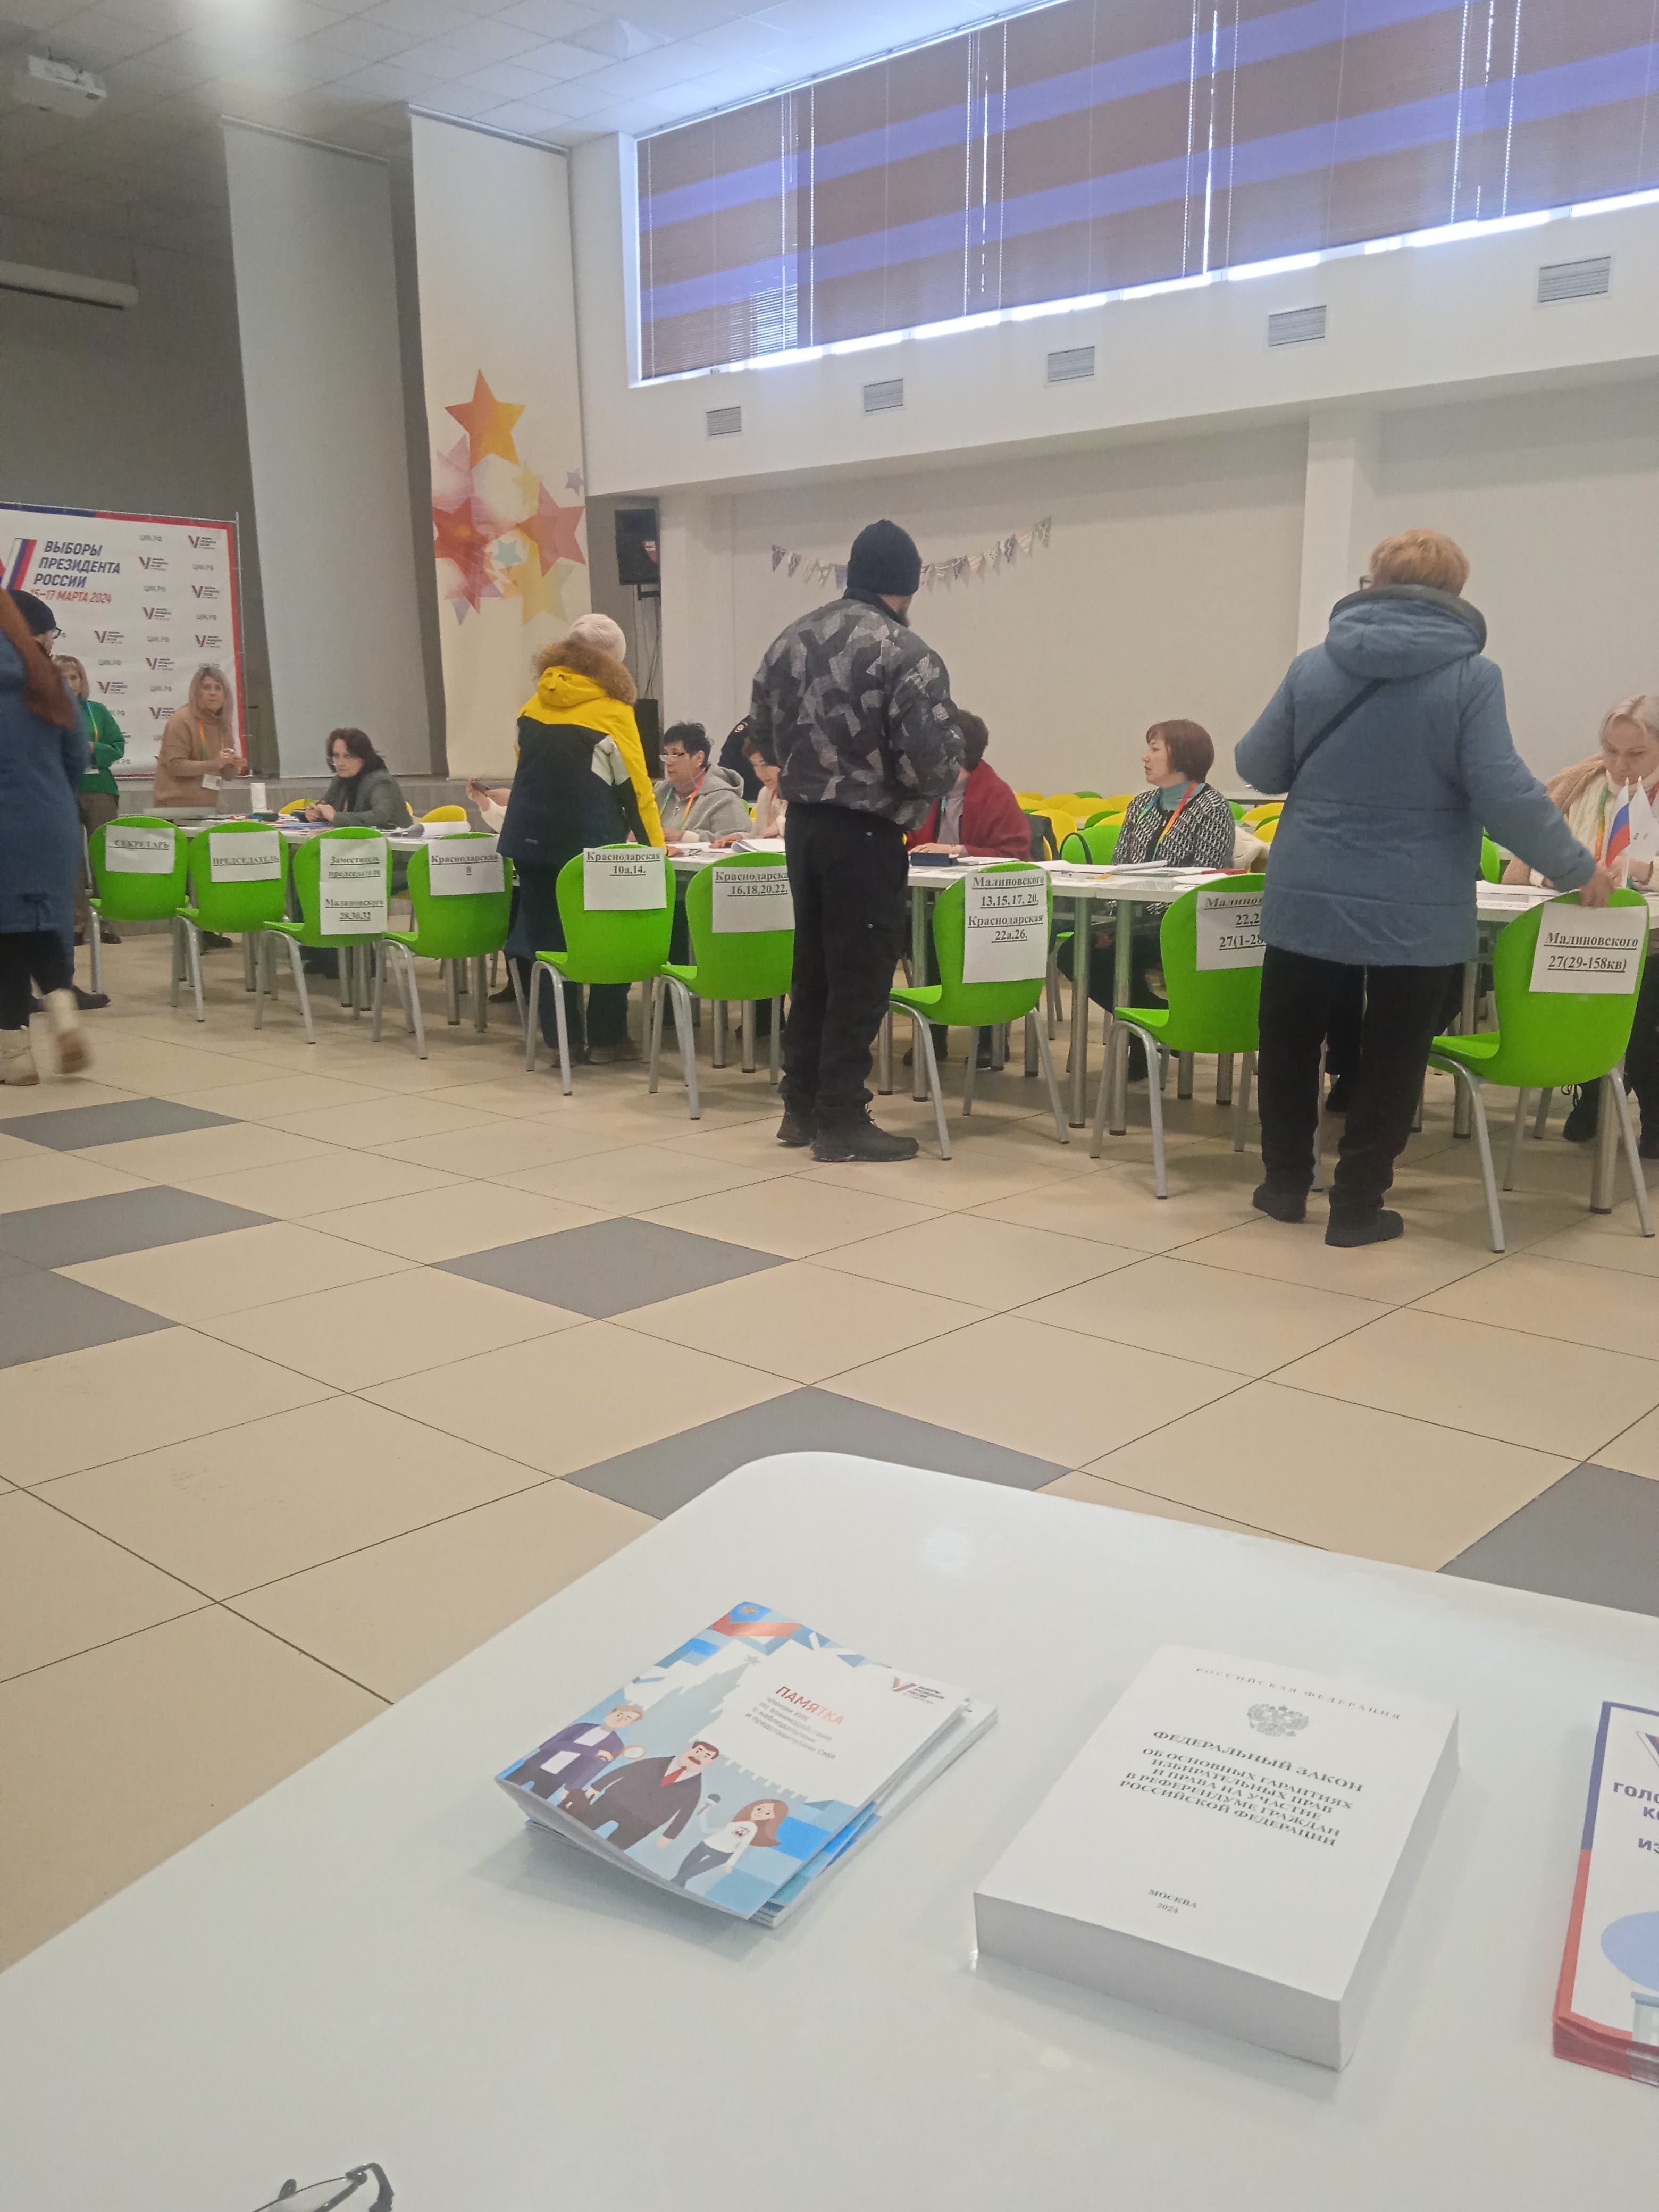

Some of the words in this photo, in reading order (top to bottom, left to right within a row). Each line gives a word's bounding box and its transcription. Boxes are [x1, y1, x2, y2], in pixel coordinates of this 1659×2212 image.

[44, 540, 103, 557] ВЫБОРЫ
[38, 556, 121, 574] ПРЕЗИДЕНТА
[33, 573, 87, 588] РОССИИ
[56, 590, 88, 602] МАРТА
[431, 852, 498, 863] Краснодарская
[586, 851, 661, 862] Краснодарская
[716, 872, 789, 882] Краснодарска
[973, 876, 1044, 887] Малиновского
[968, 915, 1043, 927] Краснодарская
[1236, 913, 1260, 926] 22,2
[1545, 932, 1638, 946] Малиновского
[1548, 955, 1627, 971] 27(29-158кв)
[775, 1686, 844, 1725] ПАМЯТКА
[1153, 1731, 1292, 1771] ФЕДЕРАЛЬНЫЙ
[1296, 1766, 1363, 1792] ЗАКОН
[1143, 1748, 1163, 1757] ОБ
[1166, 1753, 1256, 1780] ОСНОВНЫХ
[1260, 1777, 1353, 1809] ГАРАНТИЯХ
[1151, 1758, 1288, 1800] ИЗБИРАТЕЛЬНЫХ
[1292, 1795, 1333, 1813] ПРАВ
[1168, 1771, 1216, 1789] ПРАВА
[1221, 1784, 1242, 1797] НА
[1247, 1792, 1322, 1821] УЧАСТИЕ
[1119, 1780, 1230, 1814] РОССИЙСКОЙ
[1234, 1809, 1336, 1846] ФЕДЕРАЦИИ
[1139, 1774, 1258, 1811] РЕФЕРЕНДУМЕ
[1260, 1807, 1341, 1837] ГРАЖДАН
[1148, 1889, 1197, 1908] МОСКВА
